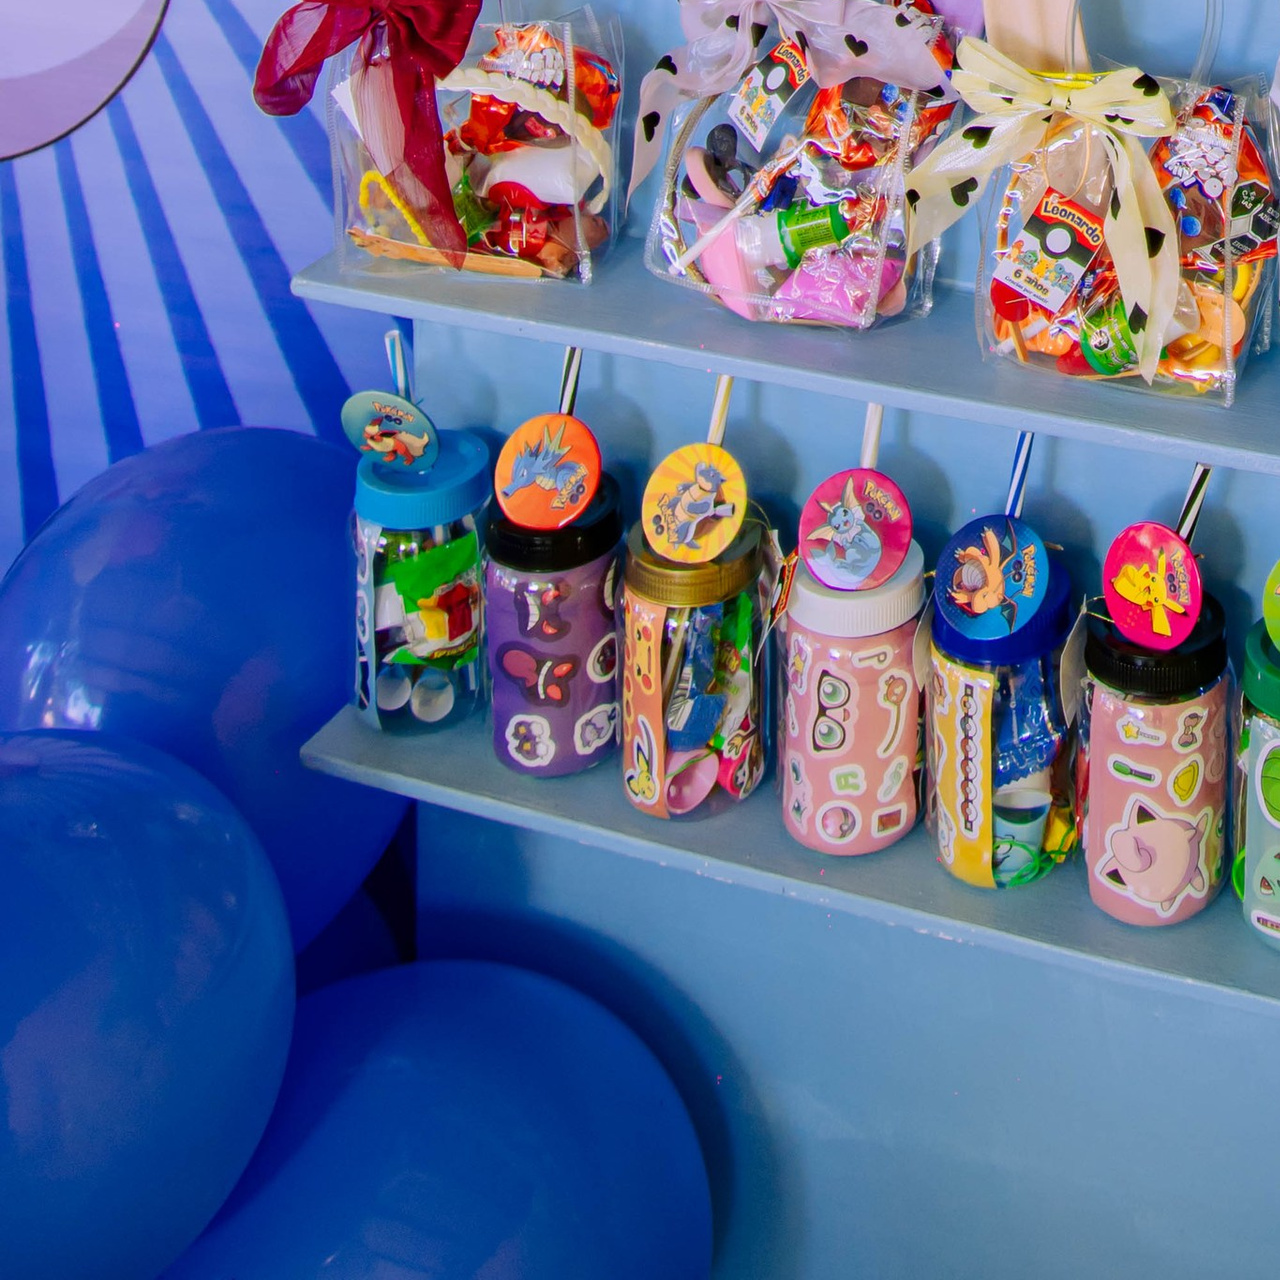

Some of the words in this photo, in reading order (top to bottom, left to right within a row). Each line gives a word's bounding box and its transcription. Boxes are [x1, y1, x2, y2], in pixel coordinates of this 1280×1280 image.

[777, 44, 807, 82] Leonardo
[1043, 200, 1101, 243] Leonardo
[1013, 269, 1023, 278] 6
[1024, 276, 1049, 295] años
